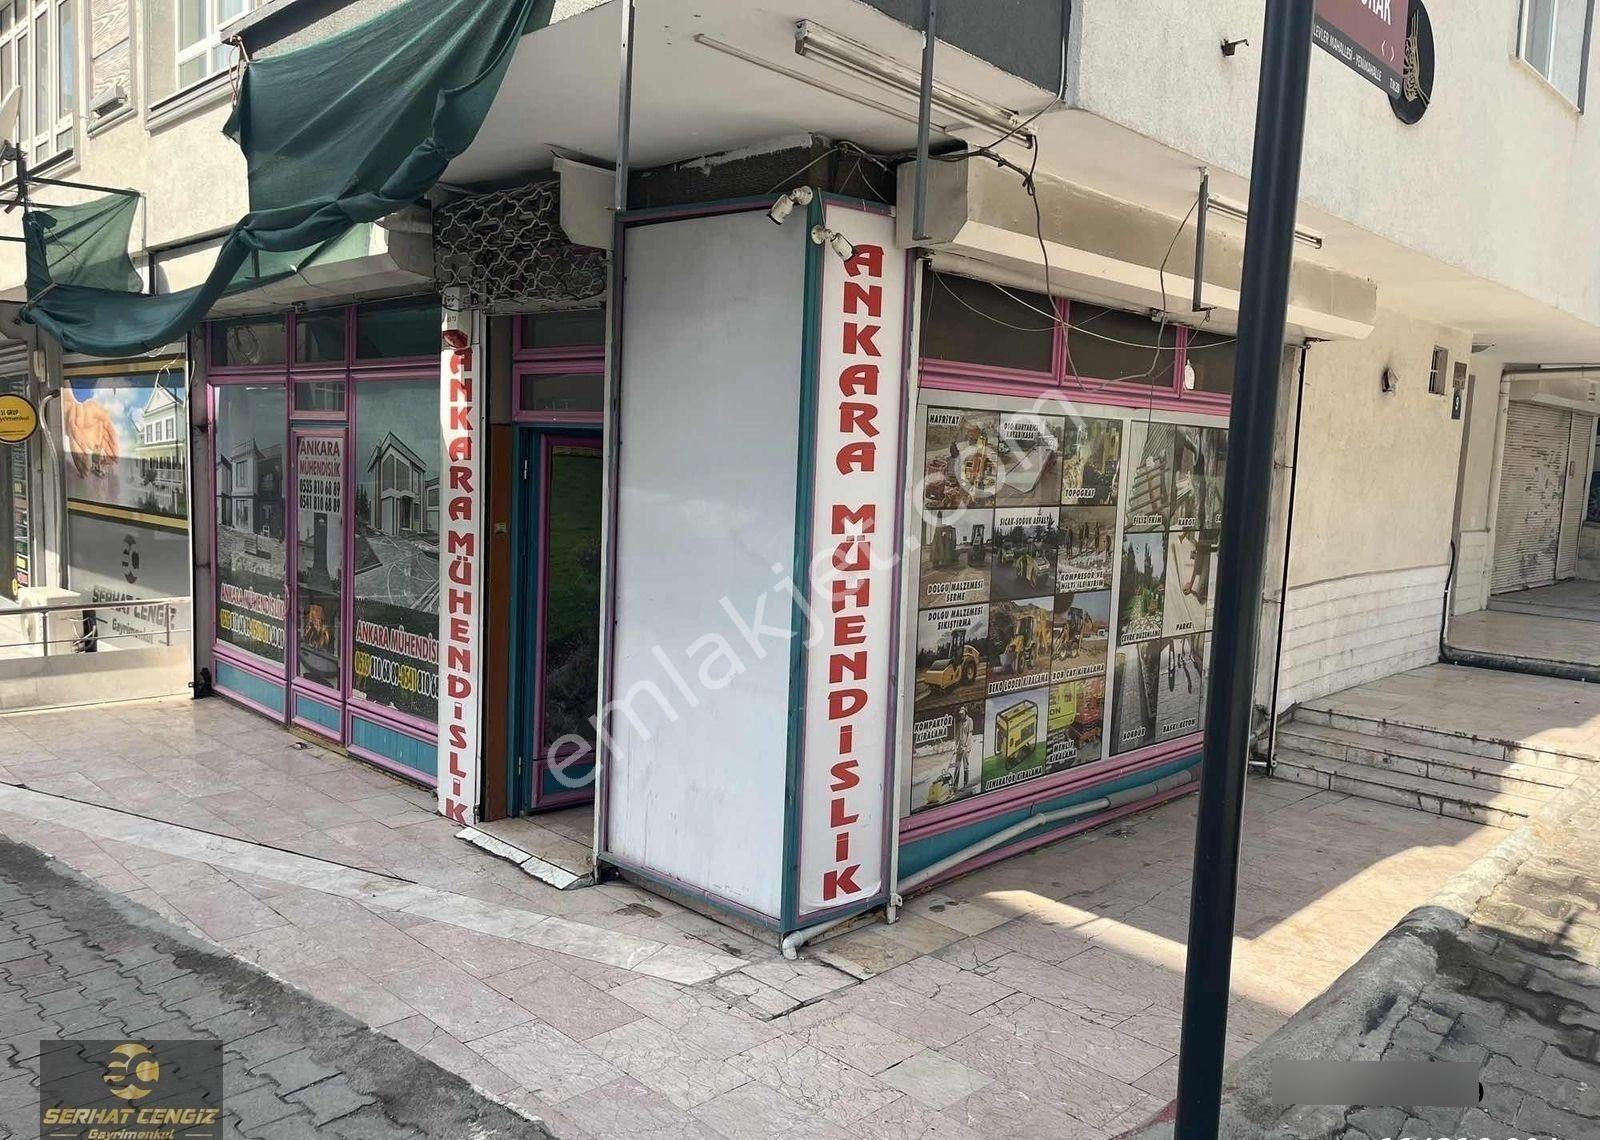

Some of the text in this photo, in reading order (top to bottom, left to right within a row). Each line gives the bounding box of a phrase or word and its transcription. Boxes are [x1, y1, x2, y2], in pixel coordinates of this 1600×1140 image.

[300, 440, 340, 457] ANKARA
[300, 456, 340, 477] MÜHENDİSLİK
[300, 478, 340, 497] 0535 810 68 89
[1064, 488, 1096, 498] TOPOGRAF
[300, 494, 340, 513] 0541 810 68 89
[822, 244, 884, 902] ANKARA MÜHENDİSLİK
[446, 347, 475, 826] ANKARA MÜHENDİSLİK
[927, 579, 984, 595] DOLGU MALZEMESİ
[945, 592, 966, 603] SERME
[927, 605, 984, 621] DOLGU MALZEMESİ
[1175, 622, 1192, 631] PARKE
[356, 620, 389, 651] ANKARA
[1052, 671, 1065, 682] BOB
[1065, 668, 1077, 678] CAT
[1180, 717, 1197, 729] BETON
